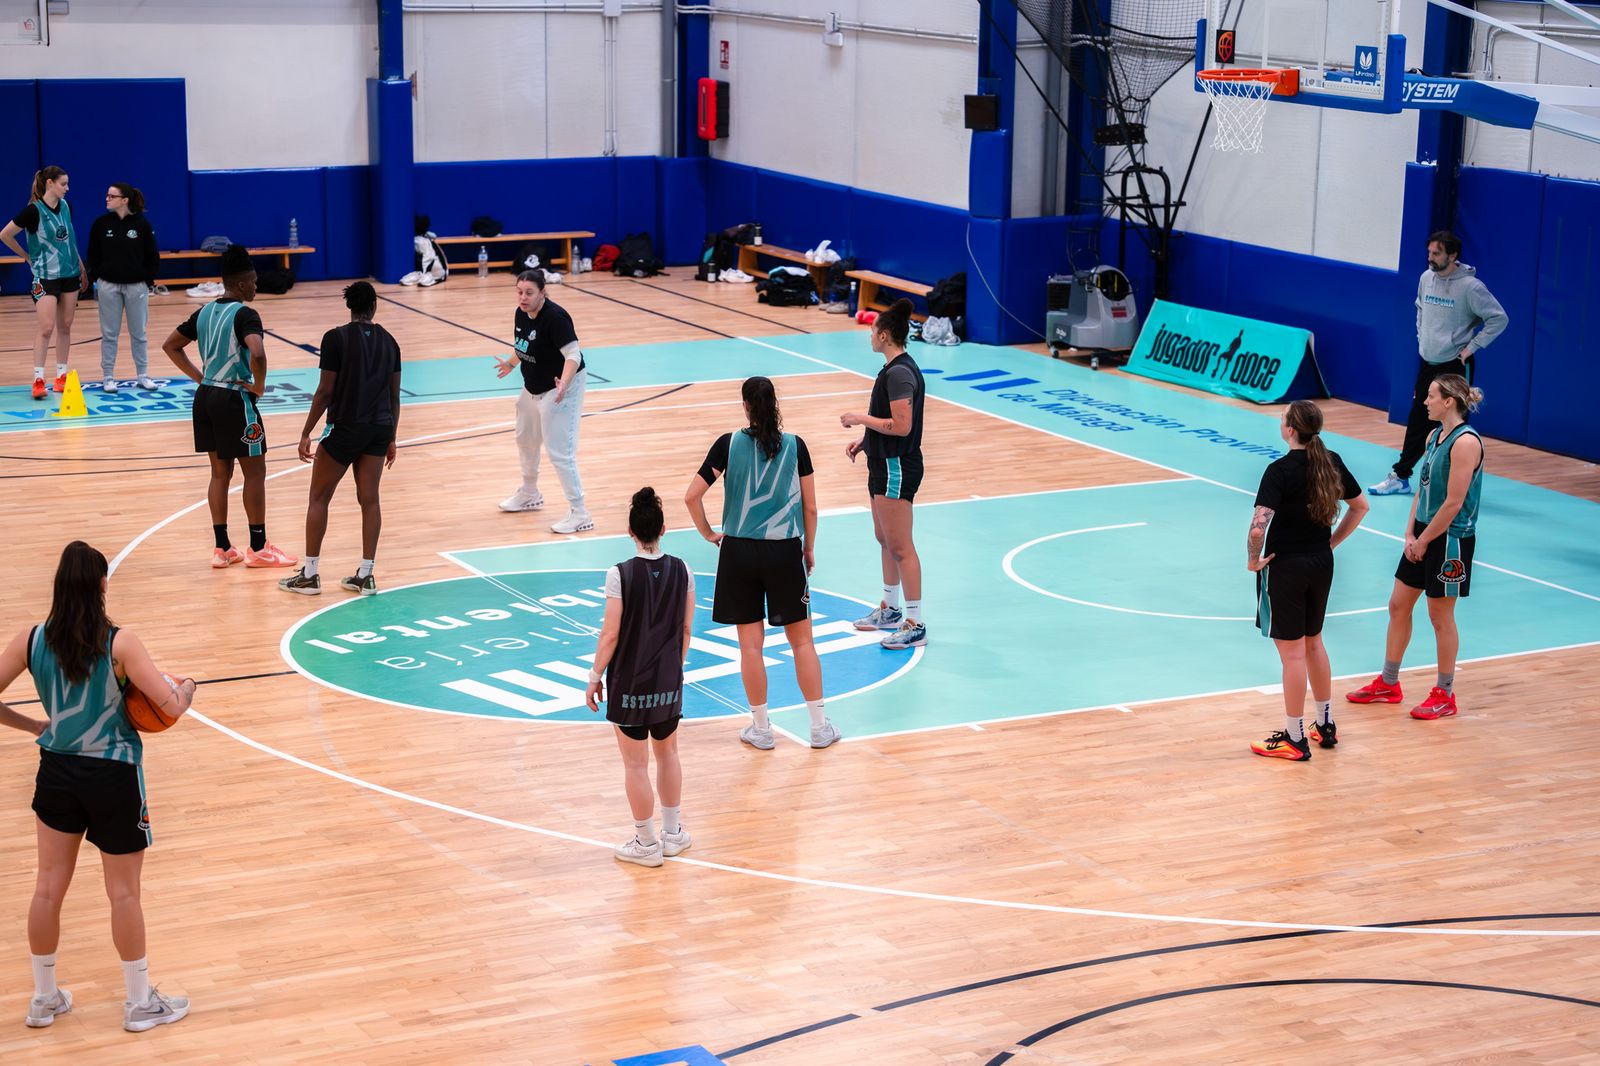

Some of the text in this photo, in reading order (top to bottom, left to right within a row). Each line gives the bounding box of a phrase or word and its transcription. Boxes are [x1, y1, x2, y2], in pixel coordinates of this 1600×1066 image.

[1145, 323, 1281, 391] jugador doce
[997, 392, 1134, 433] de Málaga
[1042, 389, 1284, 460] Diputación Provinc
[621, 689, 680, 709] ESTEPONA
